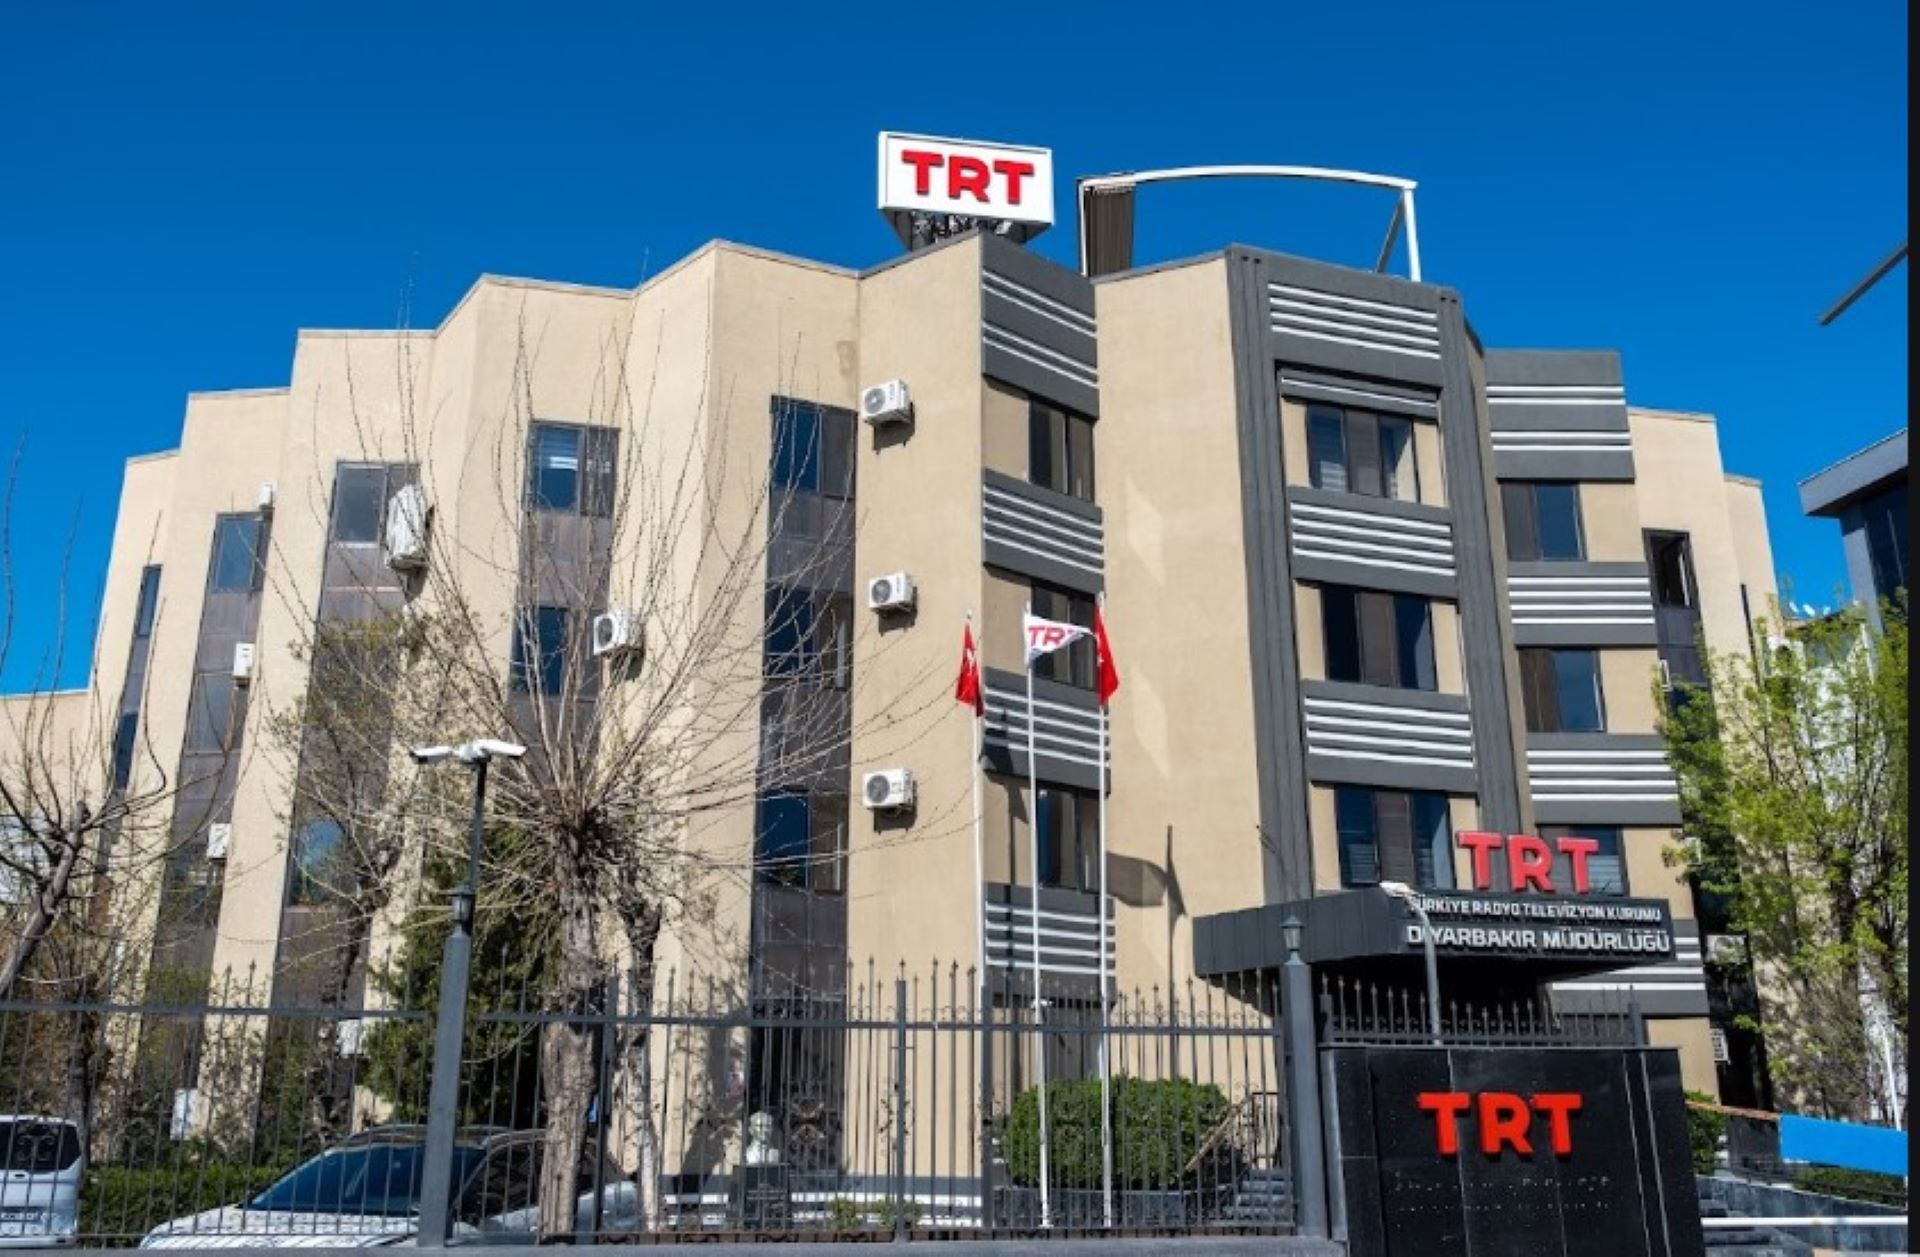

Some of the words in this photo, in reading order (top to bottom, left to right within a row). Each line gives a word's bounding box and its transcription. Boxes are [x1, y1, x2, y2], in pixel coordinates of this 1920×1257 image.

[902, 150, 1034, 206] TRT
[1456, 831, 1599, 894] TRT
[1407, 925, 1537, 948] DYARBAKIR
[1543, 926, 1670, 952] MÜDÜRLÜĞÜ
[1472, 900, 1520, 916] RADYO
[1522, 900, 1605, 919] TELEVİZYON
[1607, 906, 1662, 922] KURUMU
[1417, 1092, 1582, 1157] TRT
